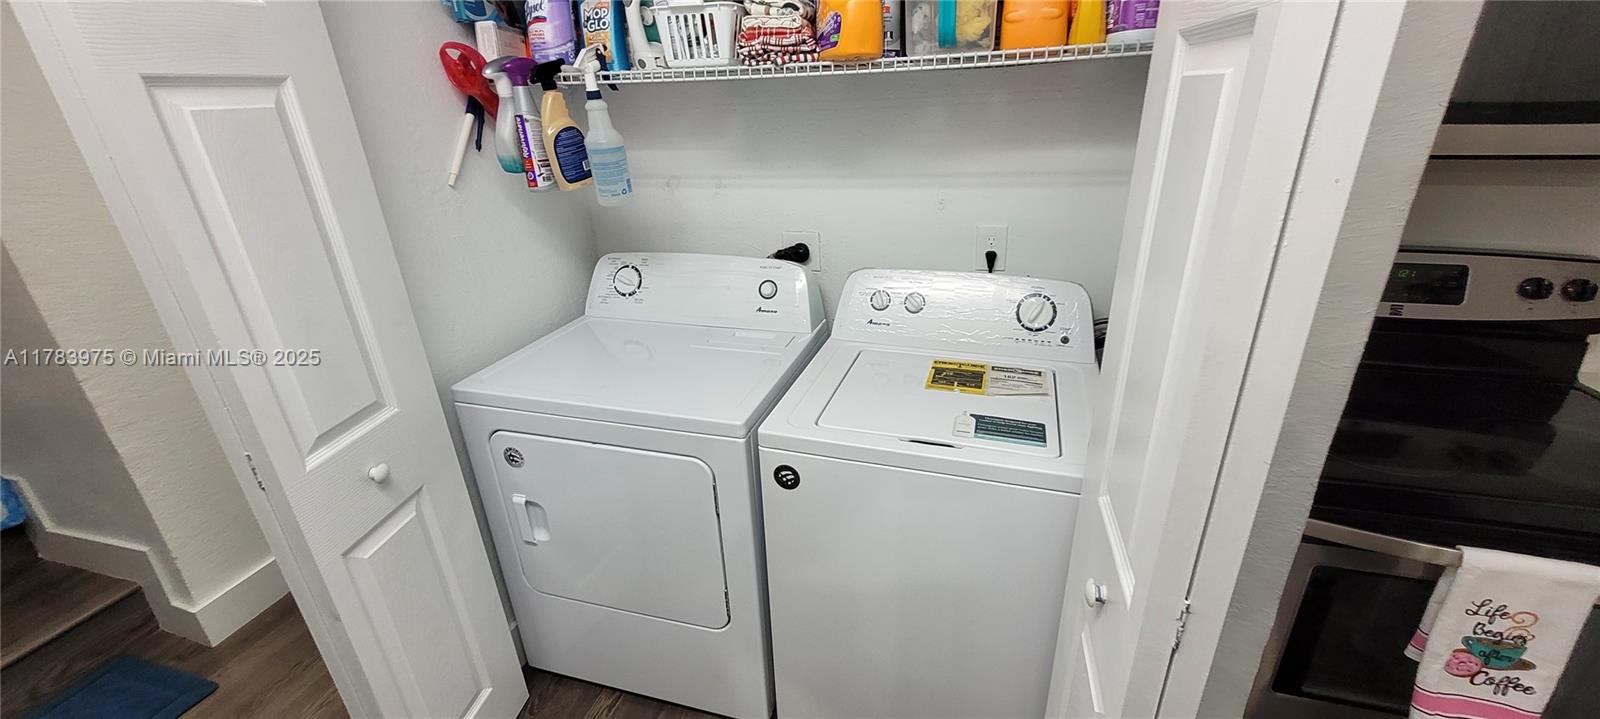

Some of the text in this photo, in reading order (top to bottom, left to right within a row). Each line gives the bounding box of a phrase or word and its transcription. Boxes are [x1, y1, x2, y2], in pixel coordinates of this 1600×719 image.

[584, 8, 608, 20] MOP
[587, 19, 609, 32] GLO
[1465, 599, 1511, 624] Life
[1479, 649, 1514, 665] after
[1469, 671, 1536, 696] Coffee
